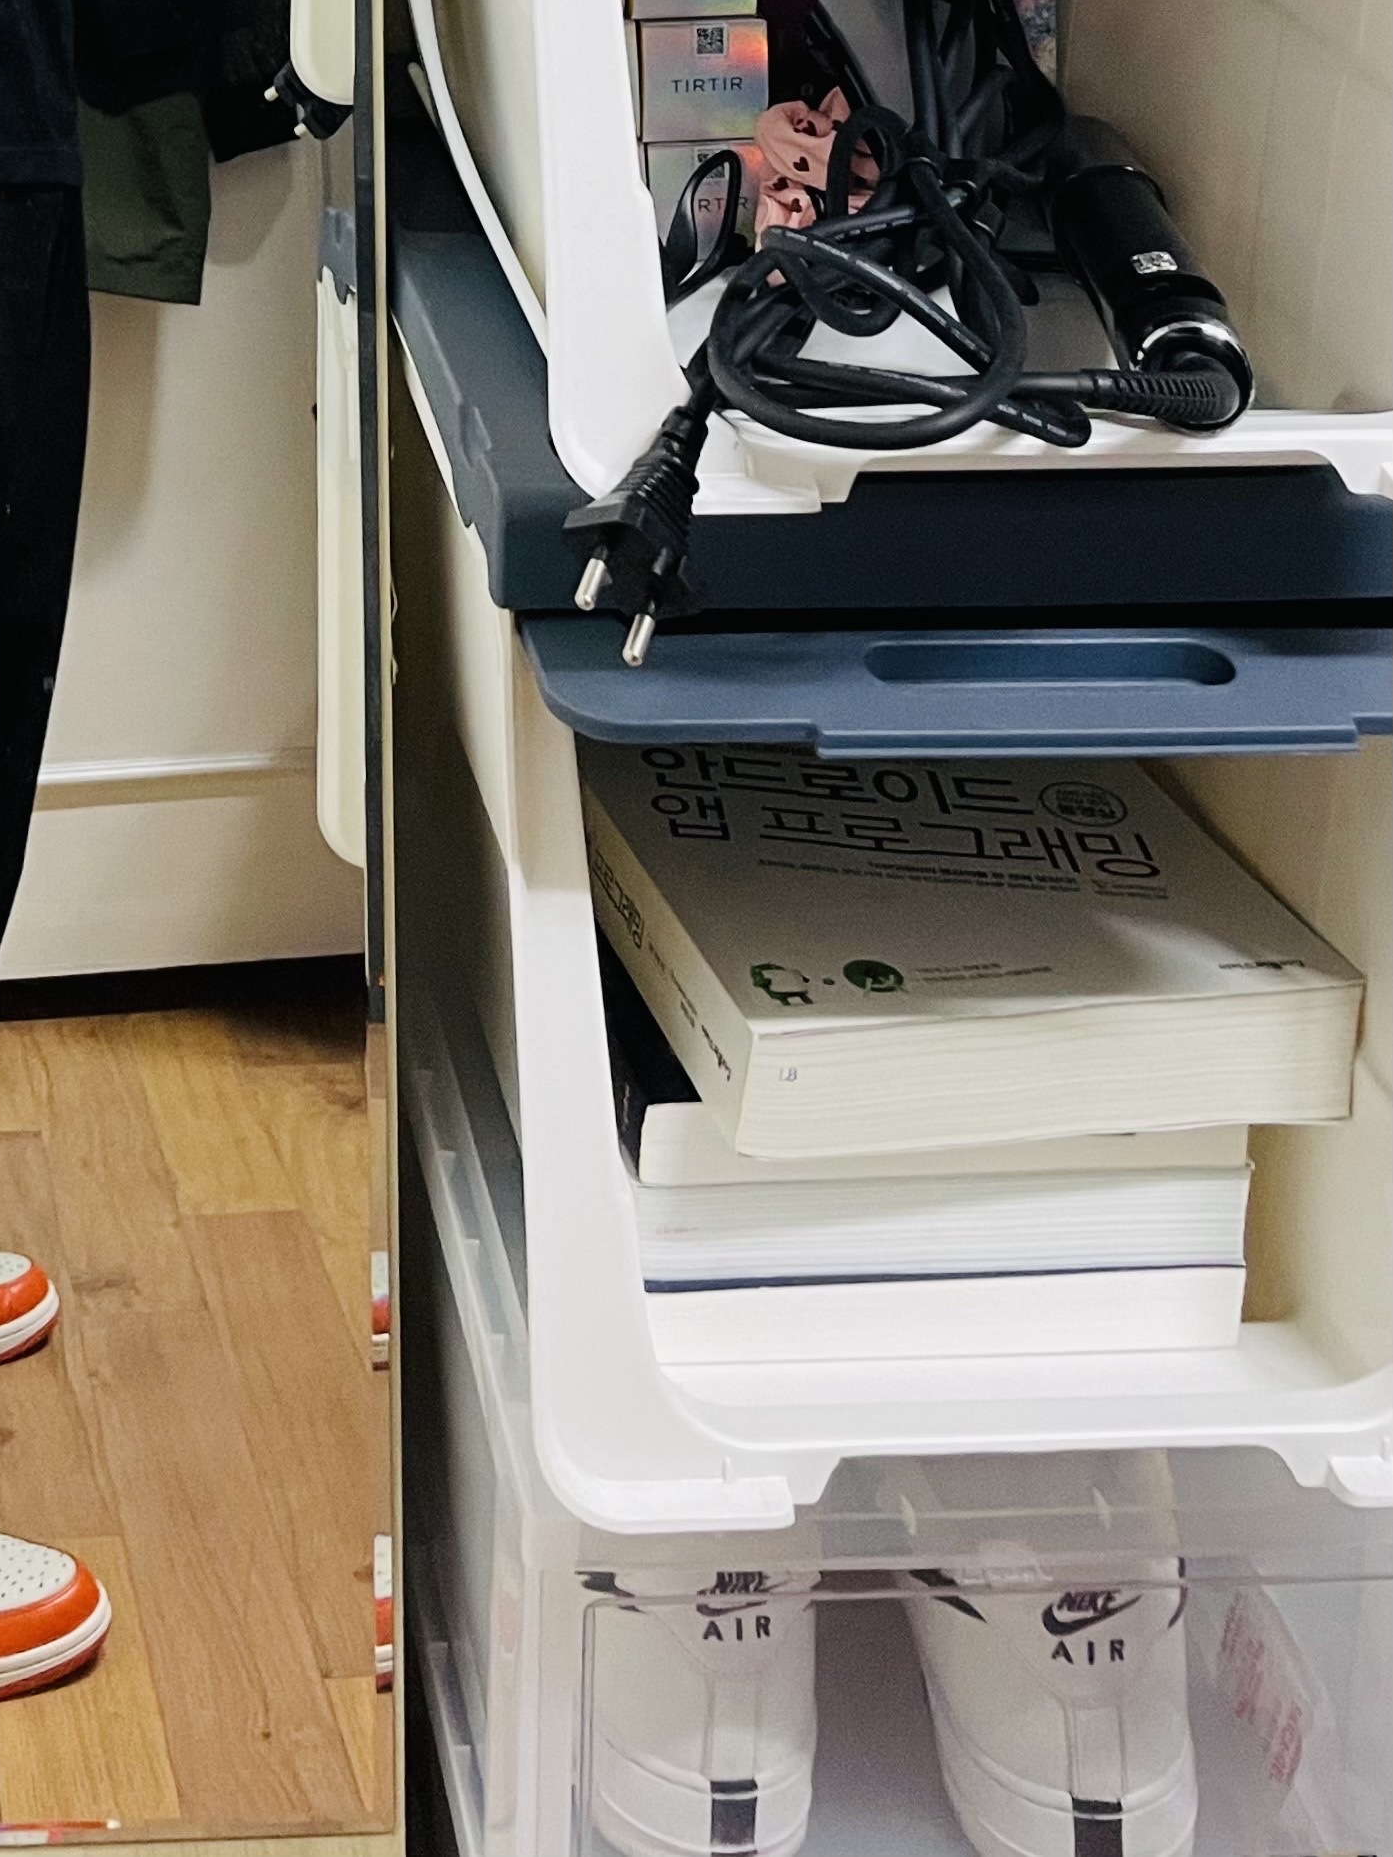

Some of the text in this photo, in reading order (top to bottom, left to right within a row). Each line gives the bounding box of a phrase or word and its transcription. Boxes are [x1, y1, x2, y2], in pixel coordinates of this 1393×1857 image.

[672, 75, 744, 94] TIRTIR
[691, 196, 749, 213] RTR
[640, 745, 1035, 817] 안드로이드
[650, 791, 732, 842] 앱
[759, 805, 1163, 878] 프로그래밍
[710, 1571, 770, 1594] NIKE
[1057, 1589, 1121, 1614] NIKE
[702, 1614, 771, 1642] AIR
[1051, 1638, 1125, 1666] AIR
